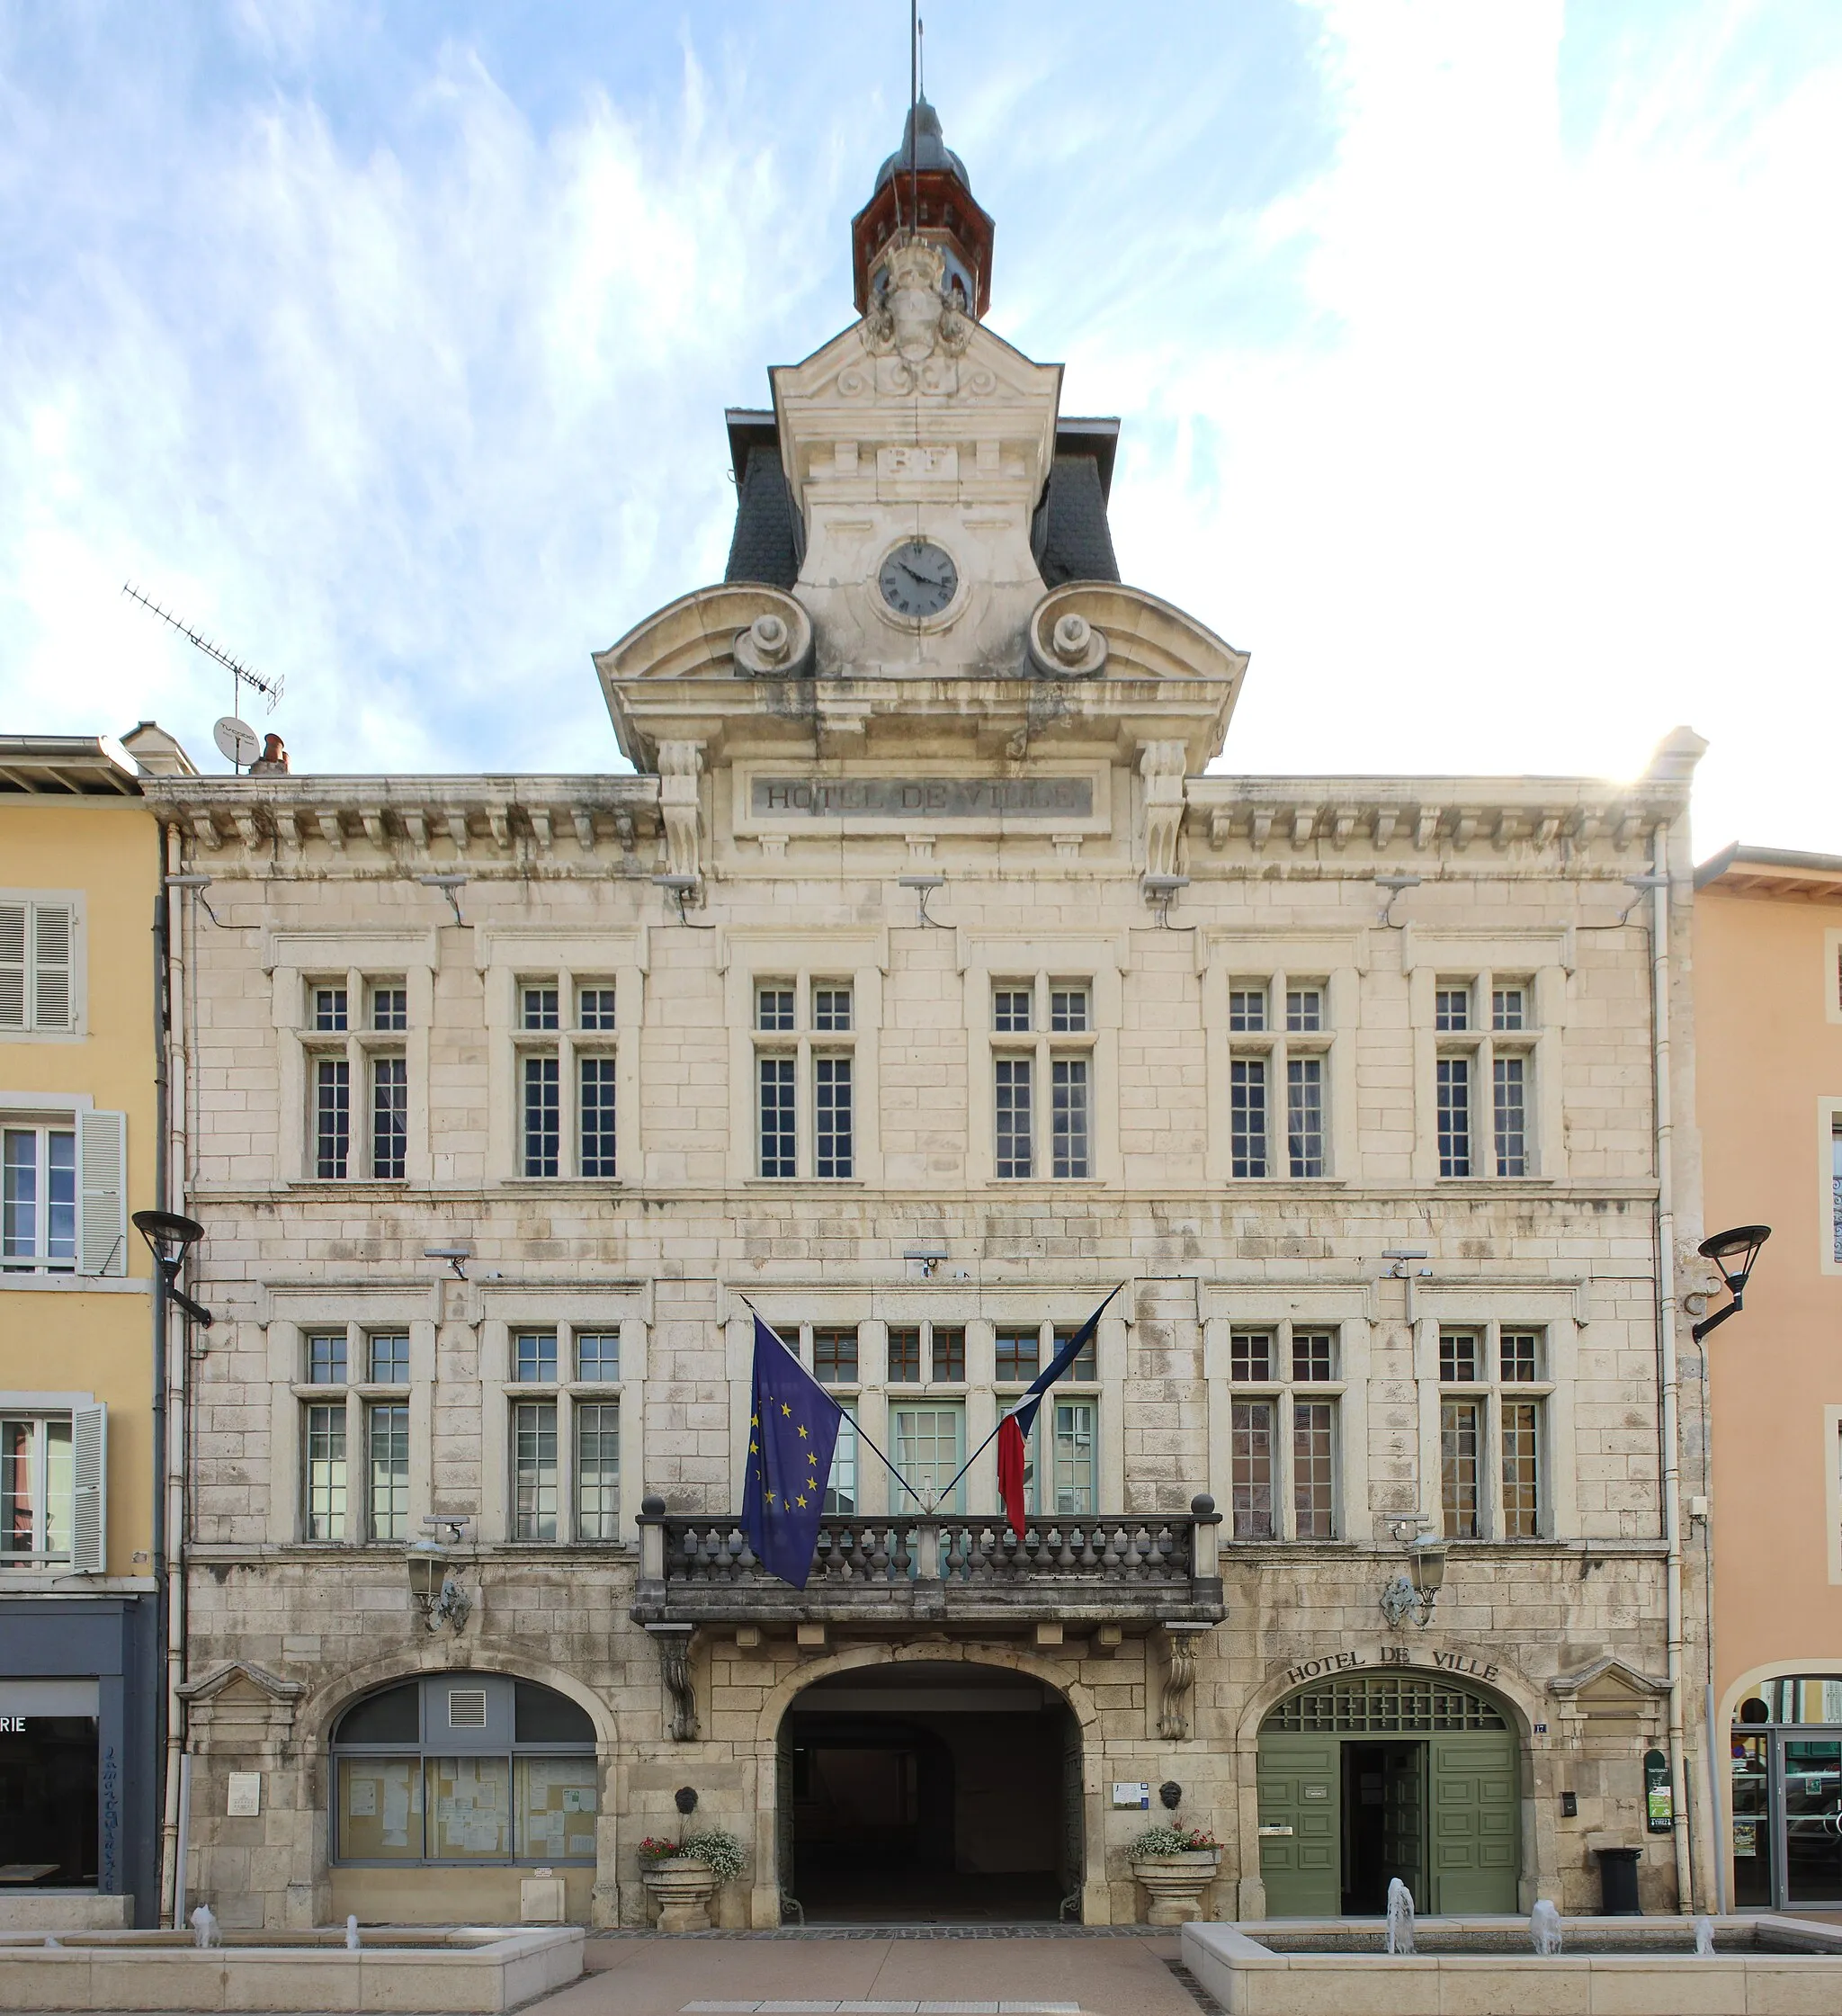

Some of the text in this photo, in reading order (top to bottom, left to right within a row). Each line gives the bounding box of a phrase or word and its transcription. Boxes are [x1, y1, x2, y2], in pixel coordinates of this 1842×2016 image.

[899, 785, 946, 809] DE
[964, 785, 1076, 809] VILLE
[1287, 1646, 1499, 1684] HOTEL DE VILLE
[0, 1716, 26, 1733] RIE
